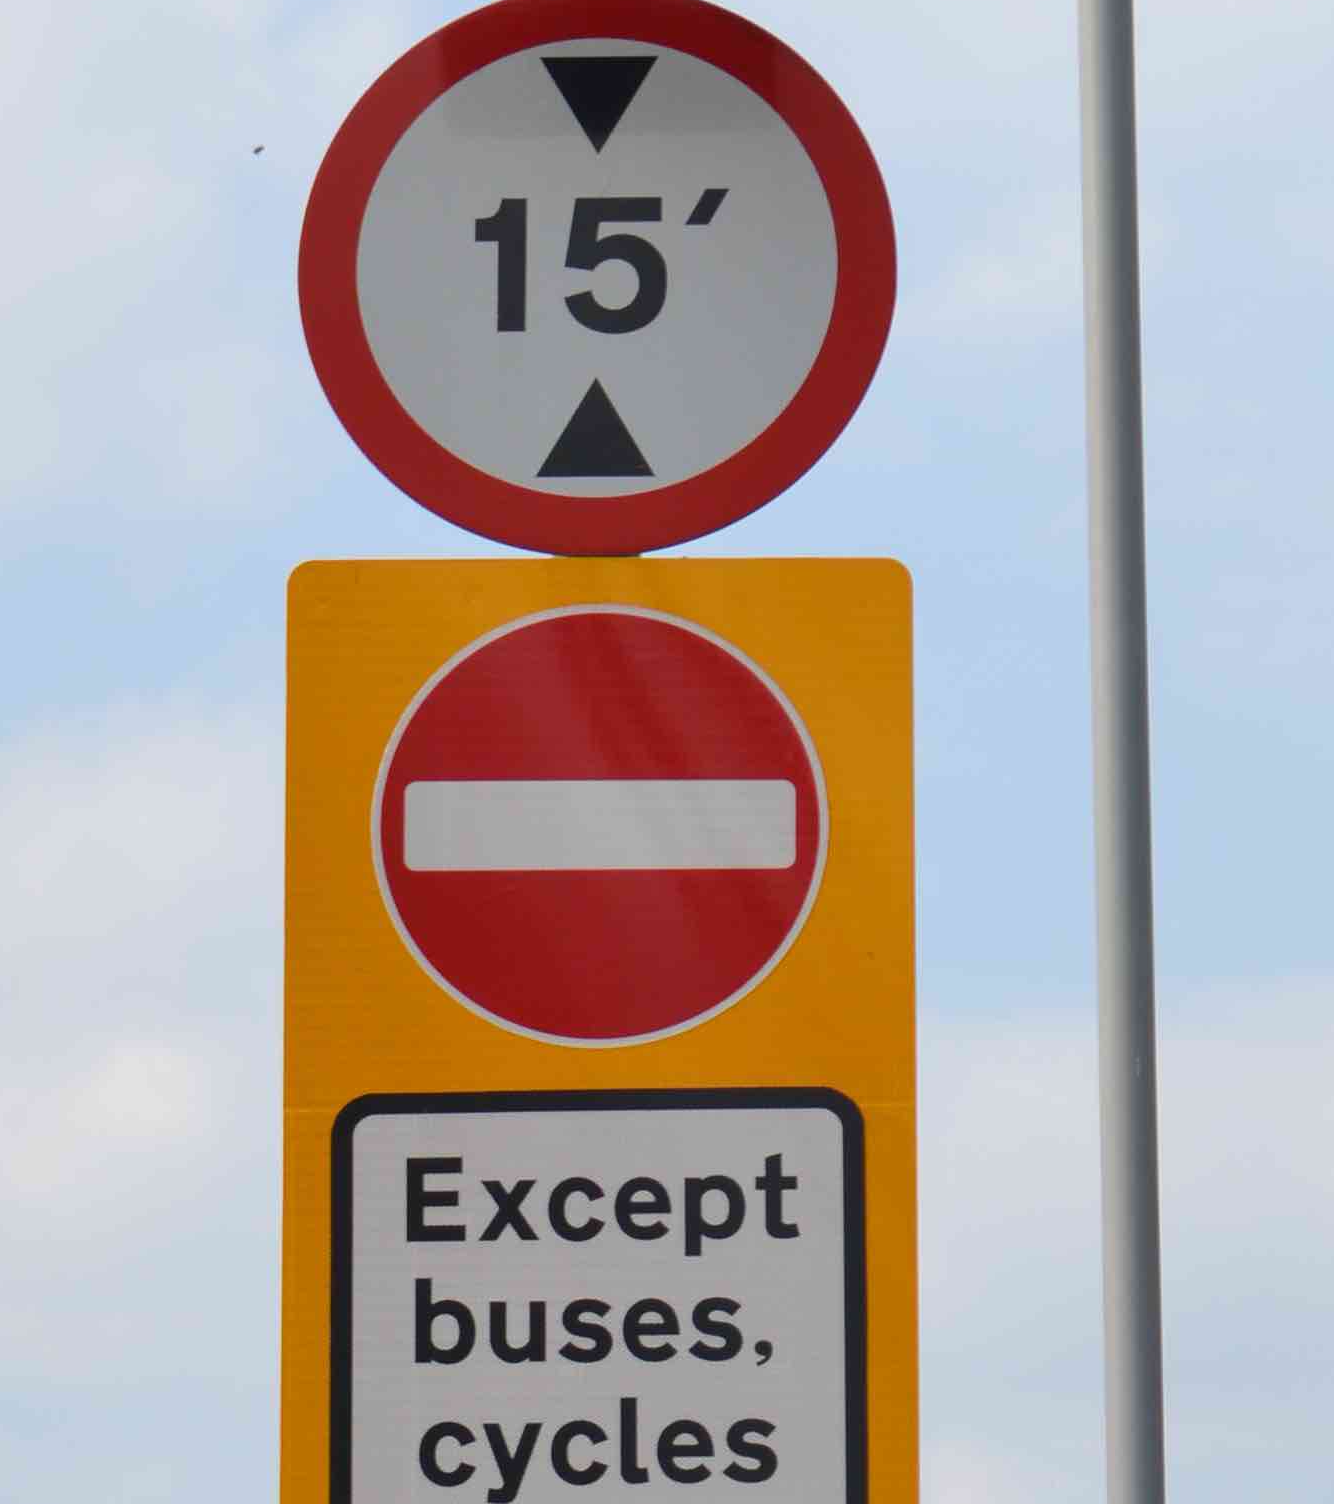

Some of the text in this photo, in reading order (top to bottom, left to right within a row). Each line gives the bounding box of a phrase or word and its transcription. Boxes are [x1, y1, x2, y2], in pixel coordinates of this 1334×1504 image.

[405, 1153, 800, 1257] Except
[414, 1277, 773, 1366] buses,
[418, 1396, 778, 1504] cycles
